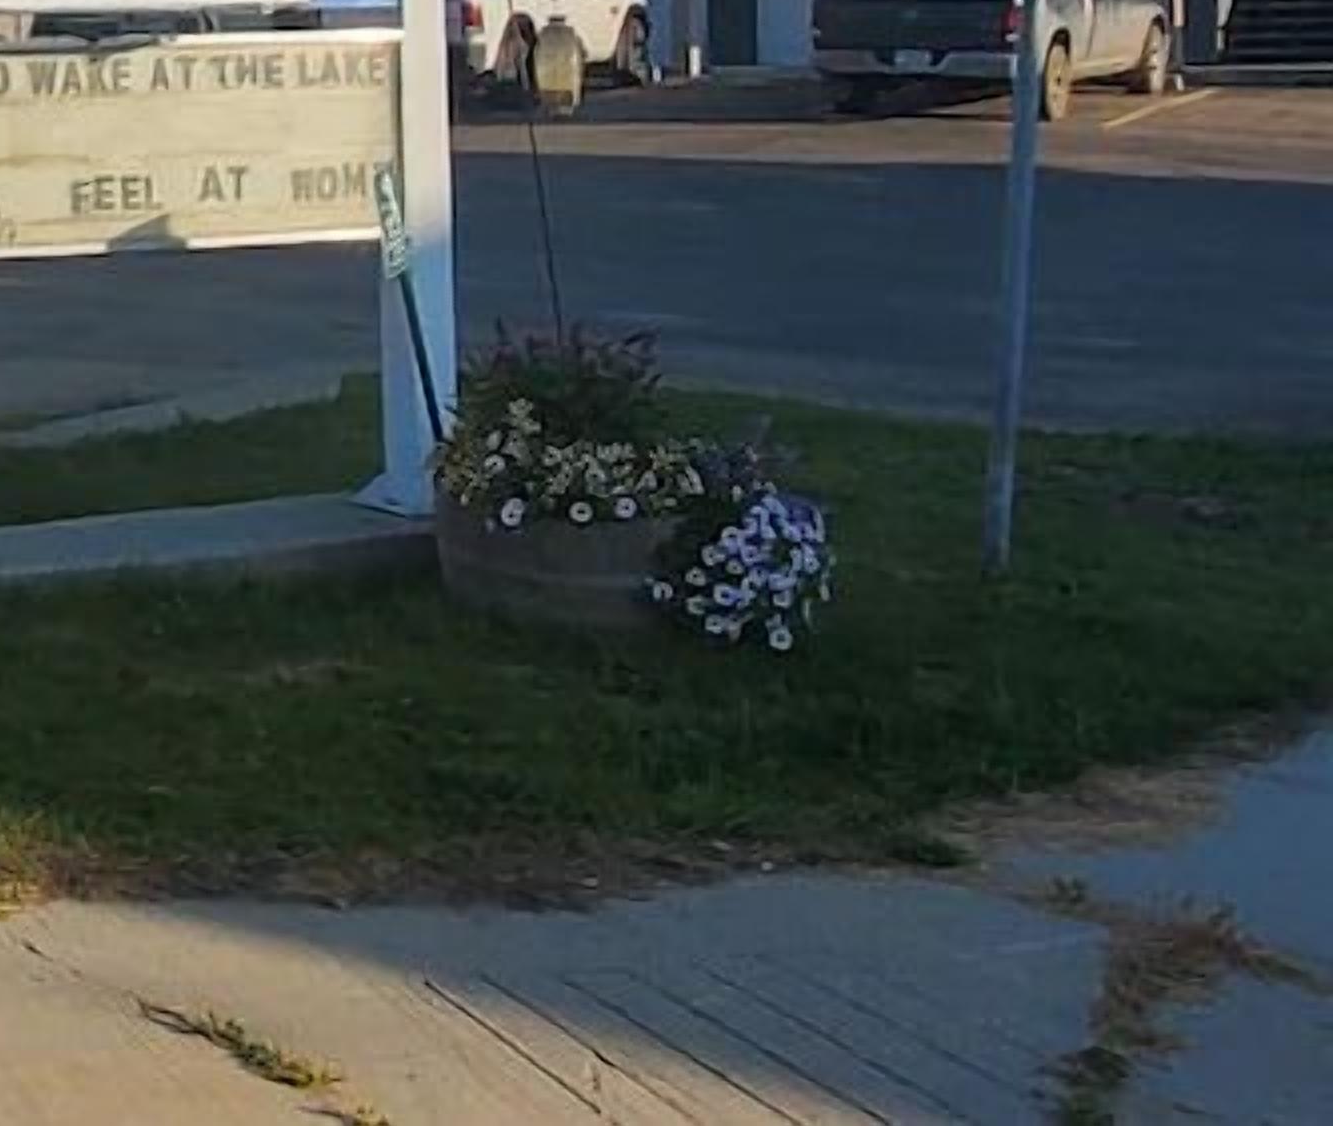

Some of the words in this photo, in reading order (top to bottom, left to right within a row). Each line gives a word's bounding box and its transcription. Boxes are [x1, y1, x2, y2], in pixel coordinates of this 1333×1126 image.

[26, 56, 132, 96] WAKE
[150, 56, 197, 91] AT
[210, 52, 285, 89] THE
[296, 50, 389, 88] LAKE
[68, 175, 163, 214] FEEL
[199, 166, 249, 202] AT
